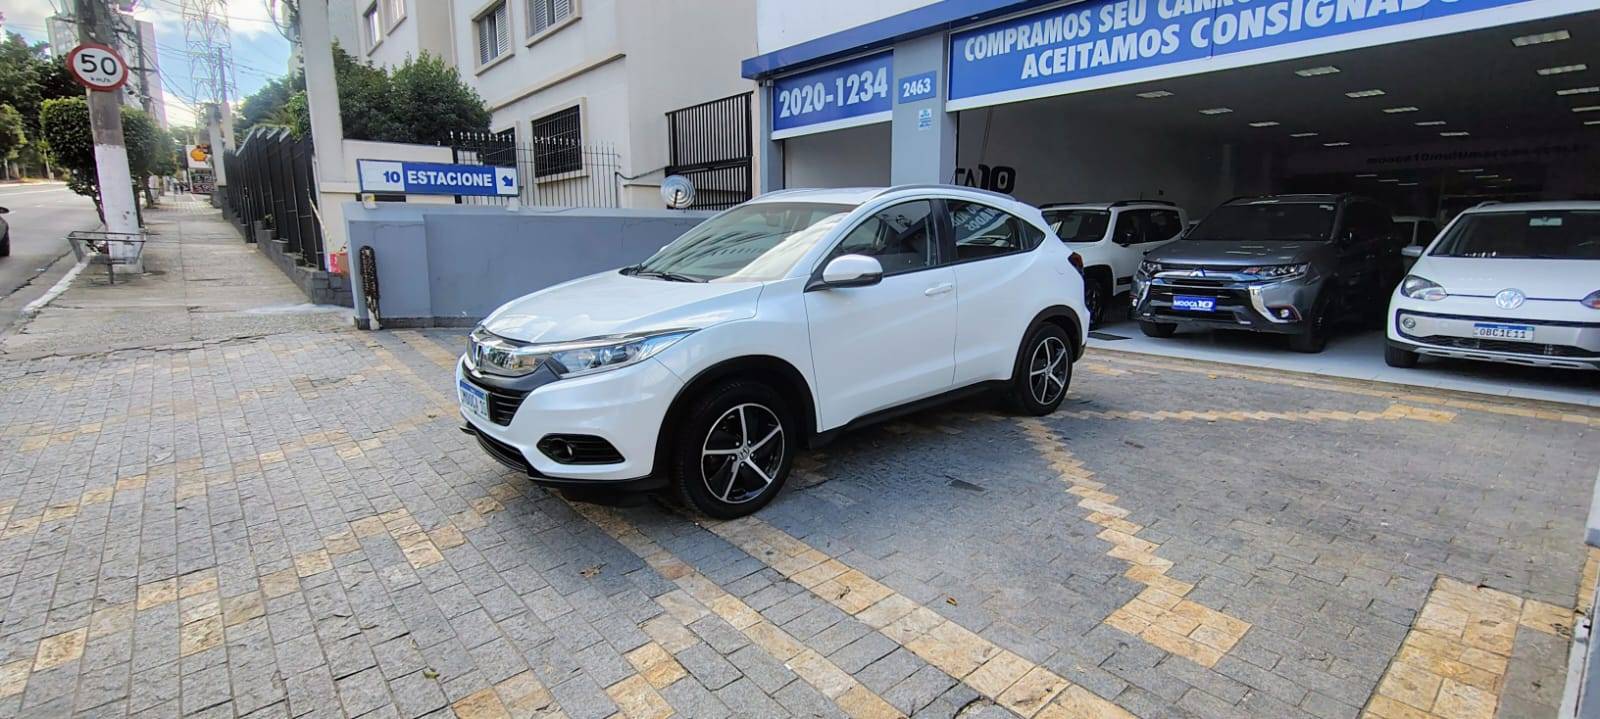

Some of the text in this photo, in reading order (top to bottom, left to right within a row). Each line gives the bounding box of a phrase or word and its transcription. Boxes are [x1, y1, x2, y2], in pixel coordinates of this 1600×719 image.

[964, 10, 1092, 62] COMPRAMOS
[1098, 0, 1147, 33] SEU
[81, 53, 117, 76] 50
[1020, 24, 1180, 80] ACEITAMOS
[779, 66, 888, 118] 2020-1234
[903, 77, 931, 98] 2463
[383, 170, 493, 187] 10 ESTACIONE
